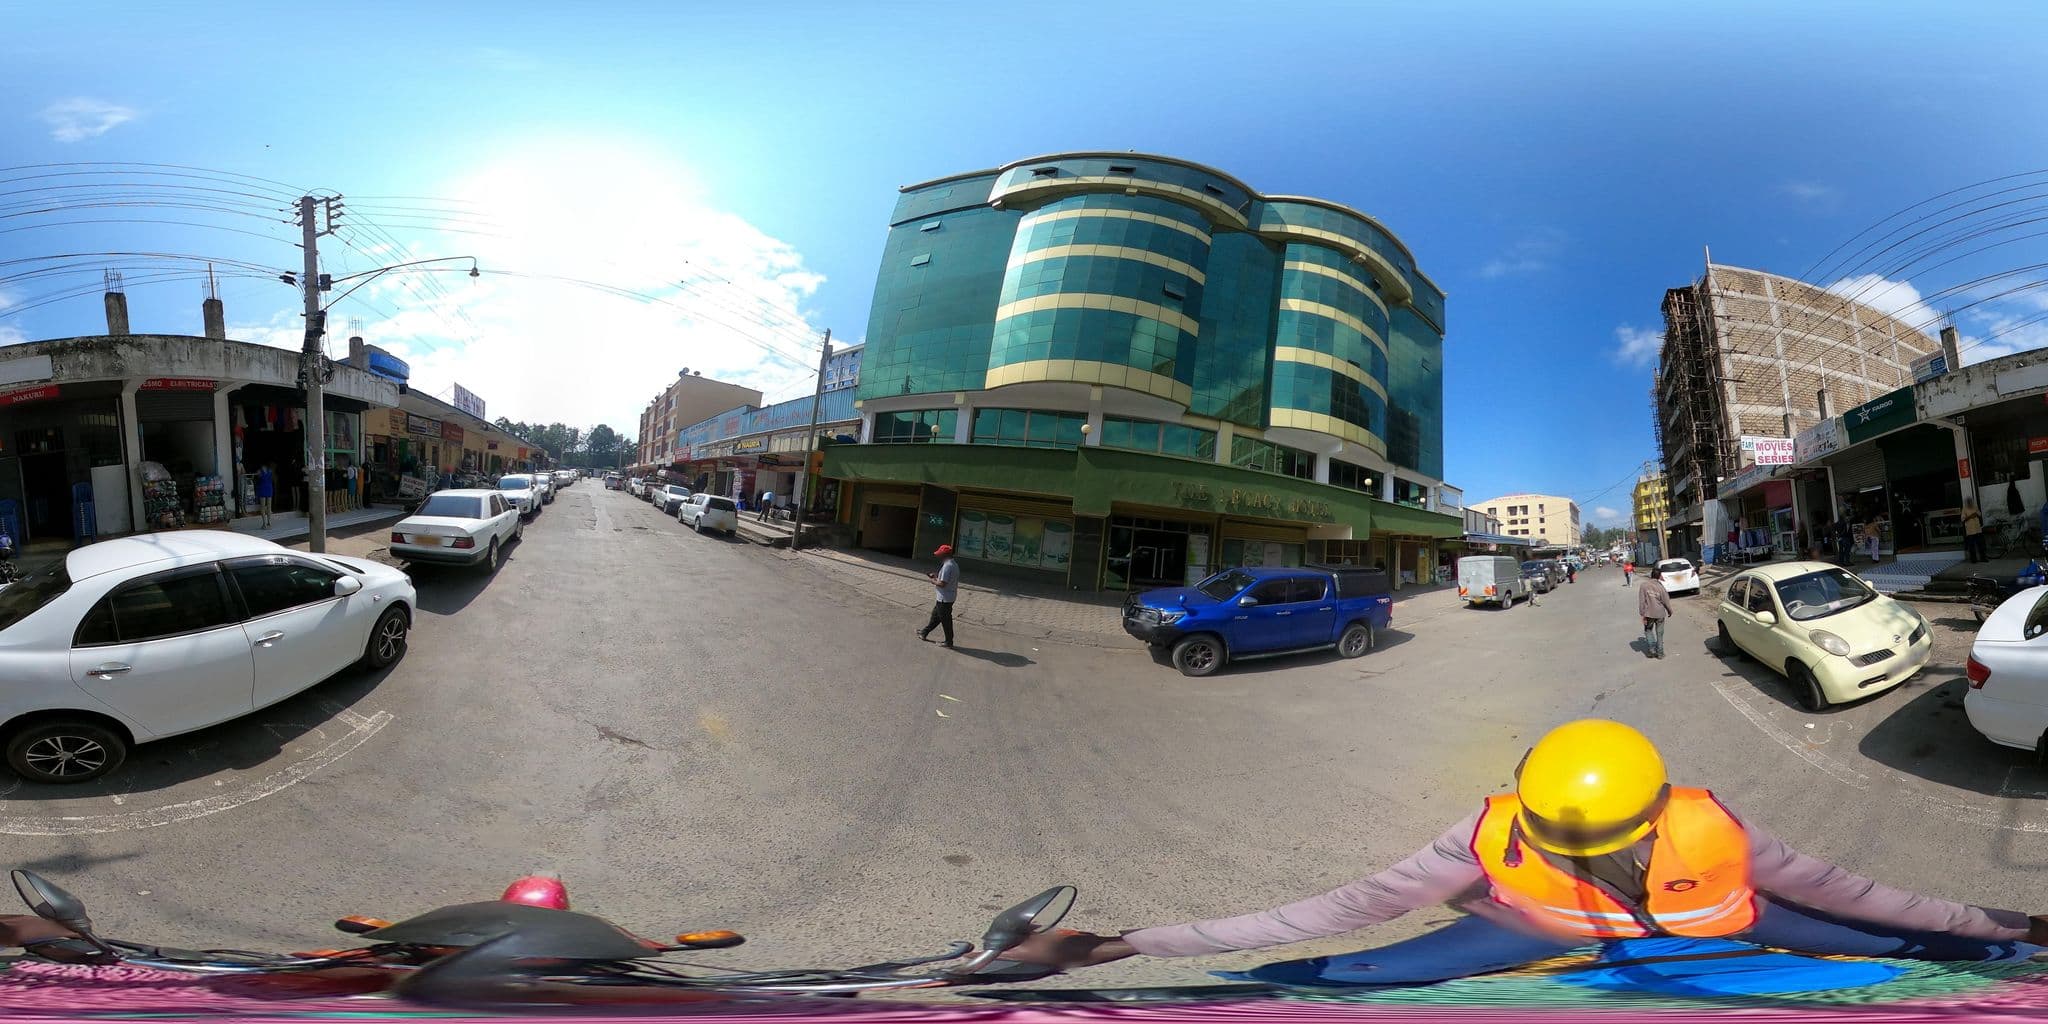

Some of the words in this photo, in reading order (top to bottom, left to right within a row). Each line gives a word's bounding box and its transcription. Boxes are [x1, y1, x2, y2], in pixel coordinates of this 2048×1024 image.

[12, 391, 46, 402] NAKURU
[1872, 399, 1893, 412] FARGO
[1755, 441, 1793, 451] MOVIES
[1757, 455, 1795, 464] SERIES
